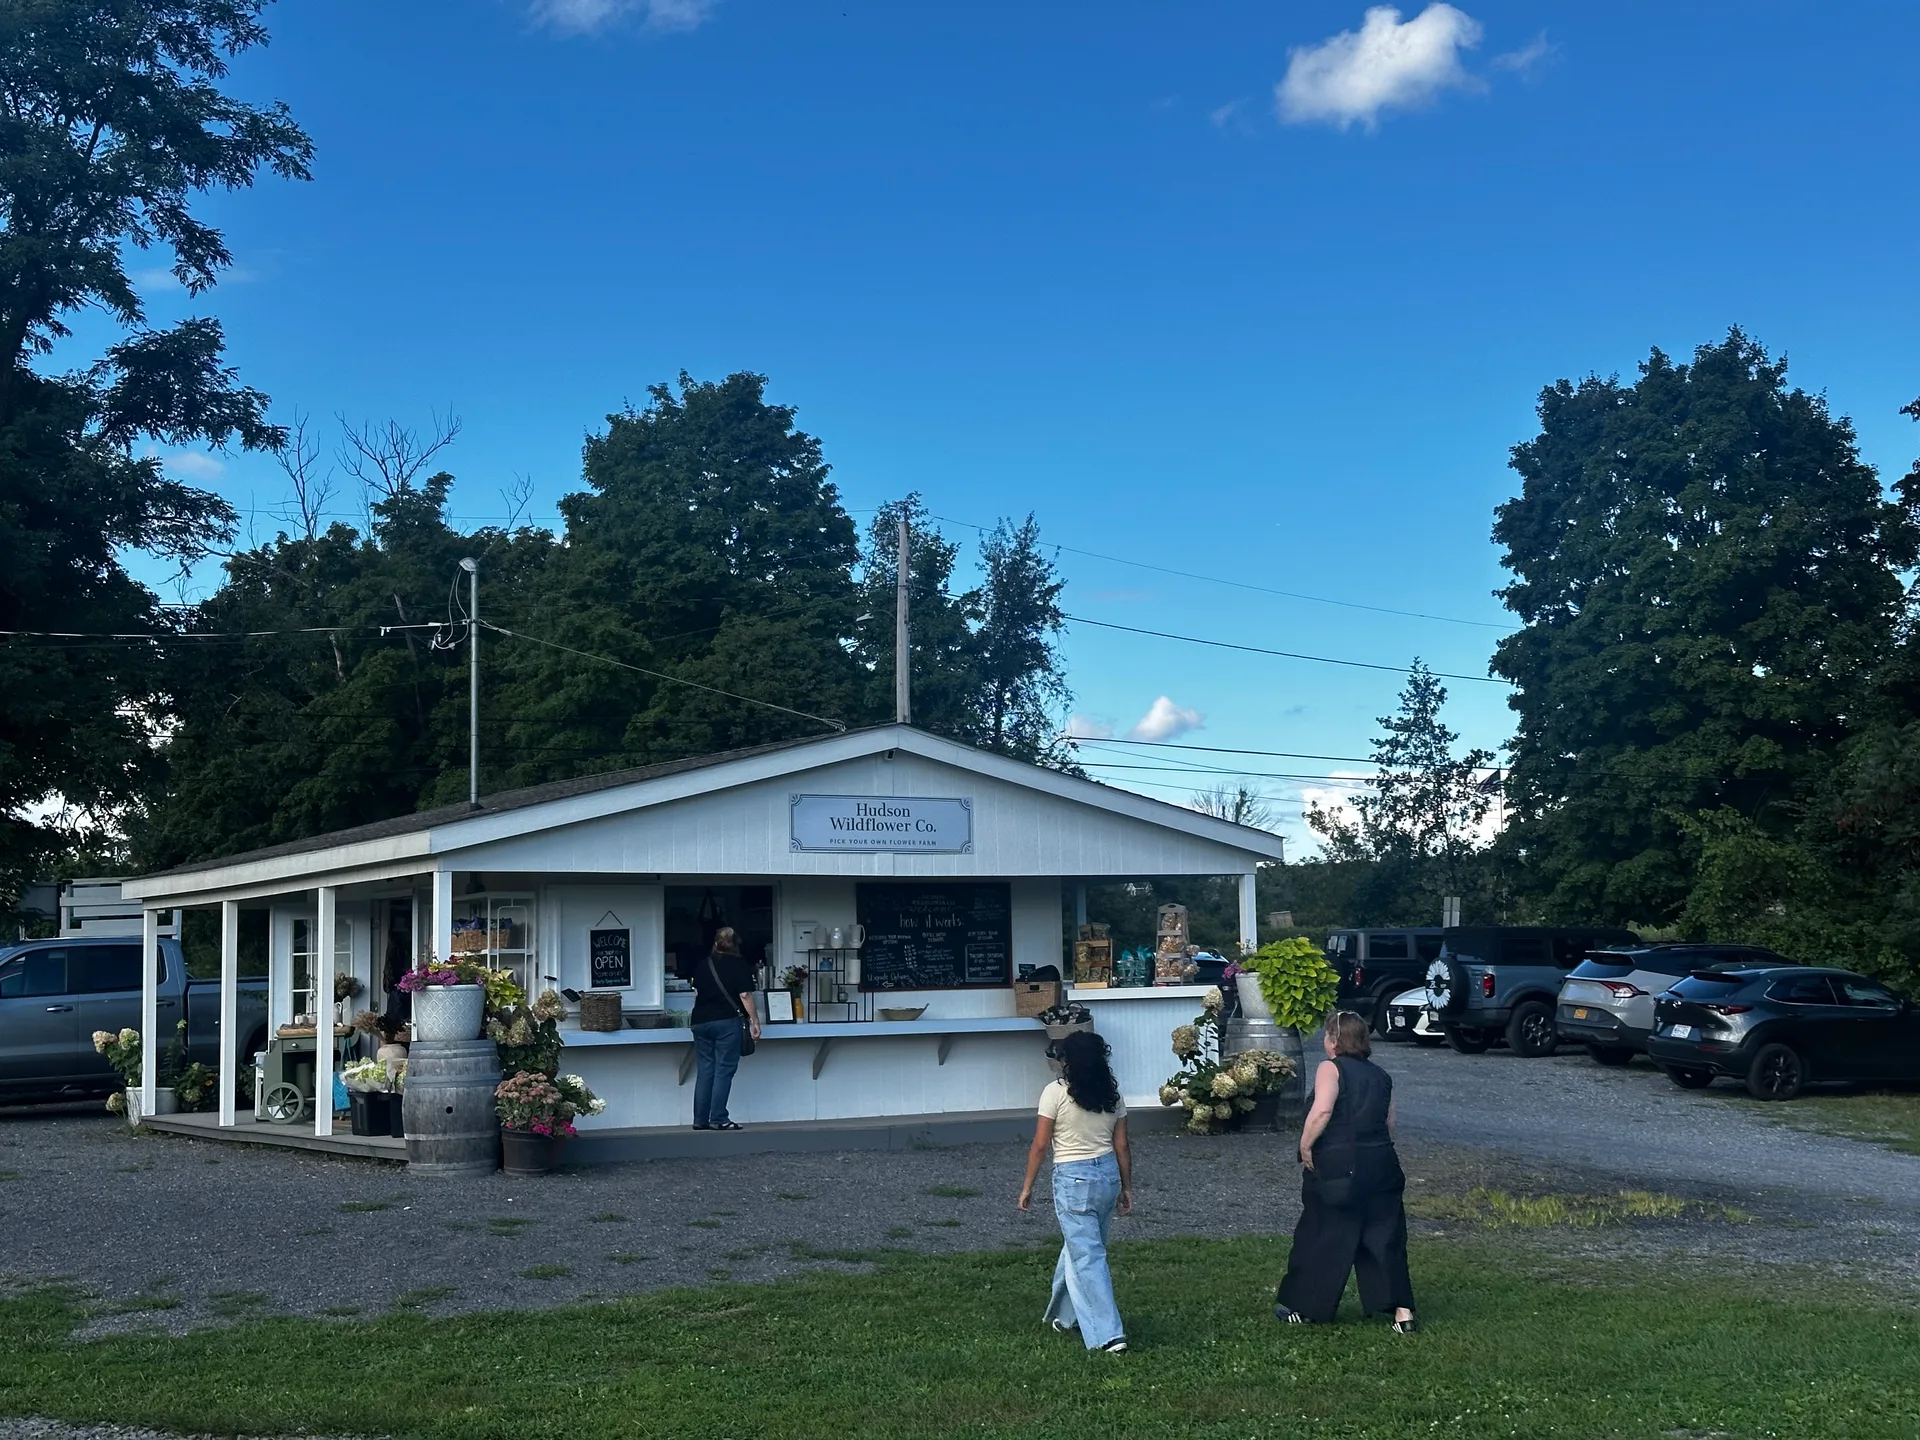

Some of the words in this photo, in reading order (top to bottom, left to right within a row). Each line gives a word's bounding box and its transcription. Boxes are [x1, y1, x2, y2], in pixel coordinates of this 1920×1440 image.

[856, 803, 911, 818] Hudson
[829, 817, 911, 833] Wildflower
[915, 819, 937, 833] Co.
[899, 913, 918, 928] how
[592, 934, 627, 949] WELCOME
[594, 955, 624, 970] OPEN
